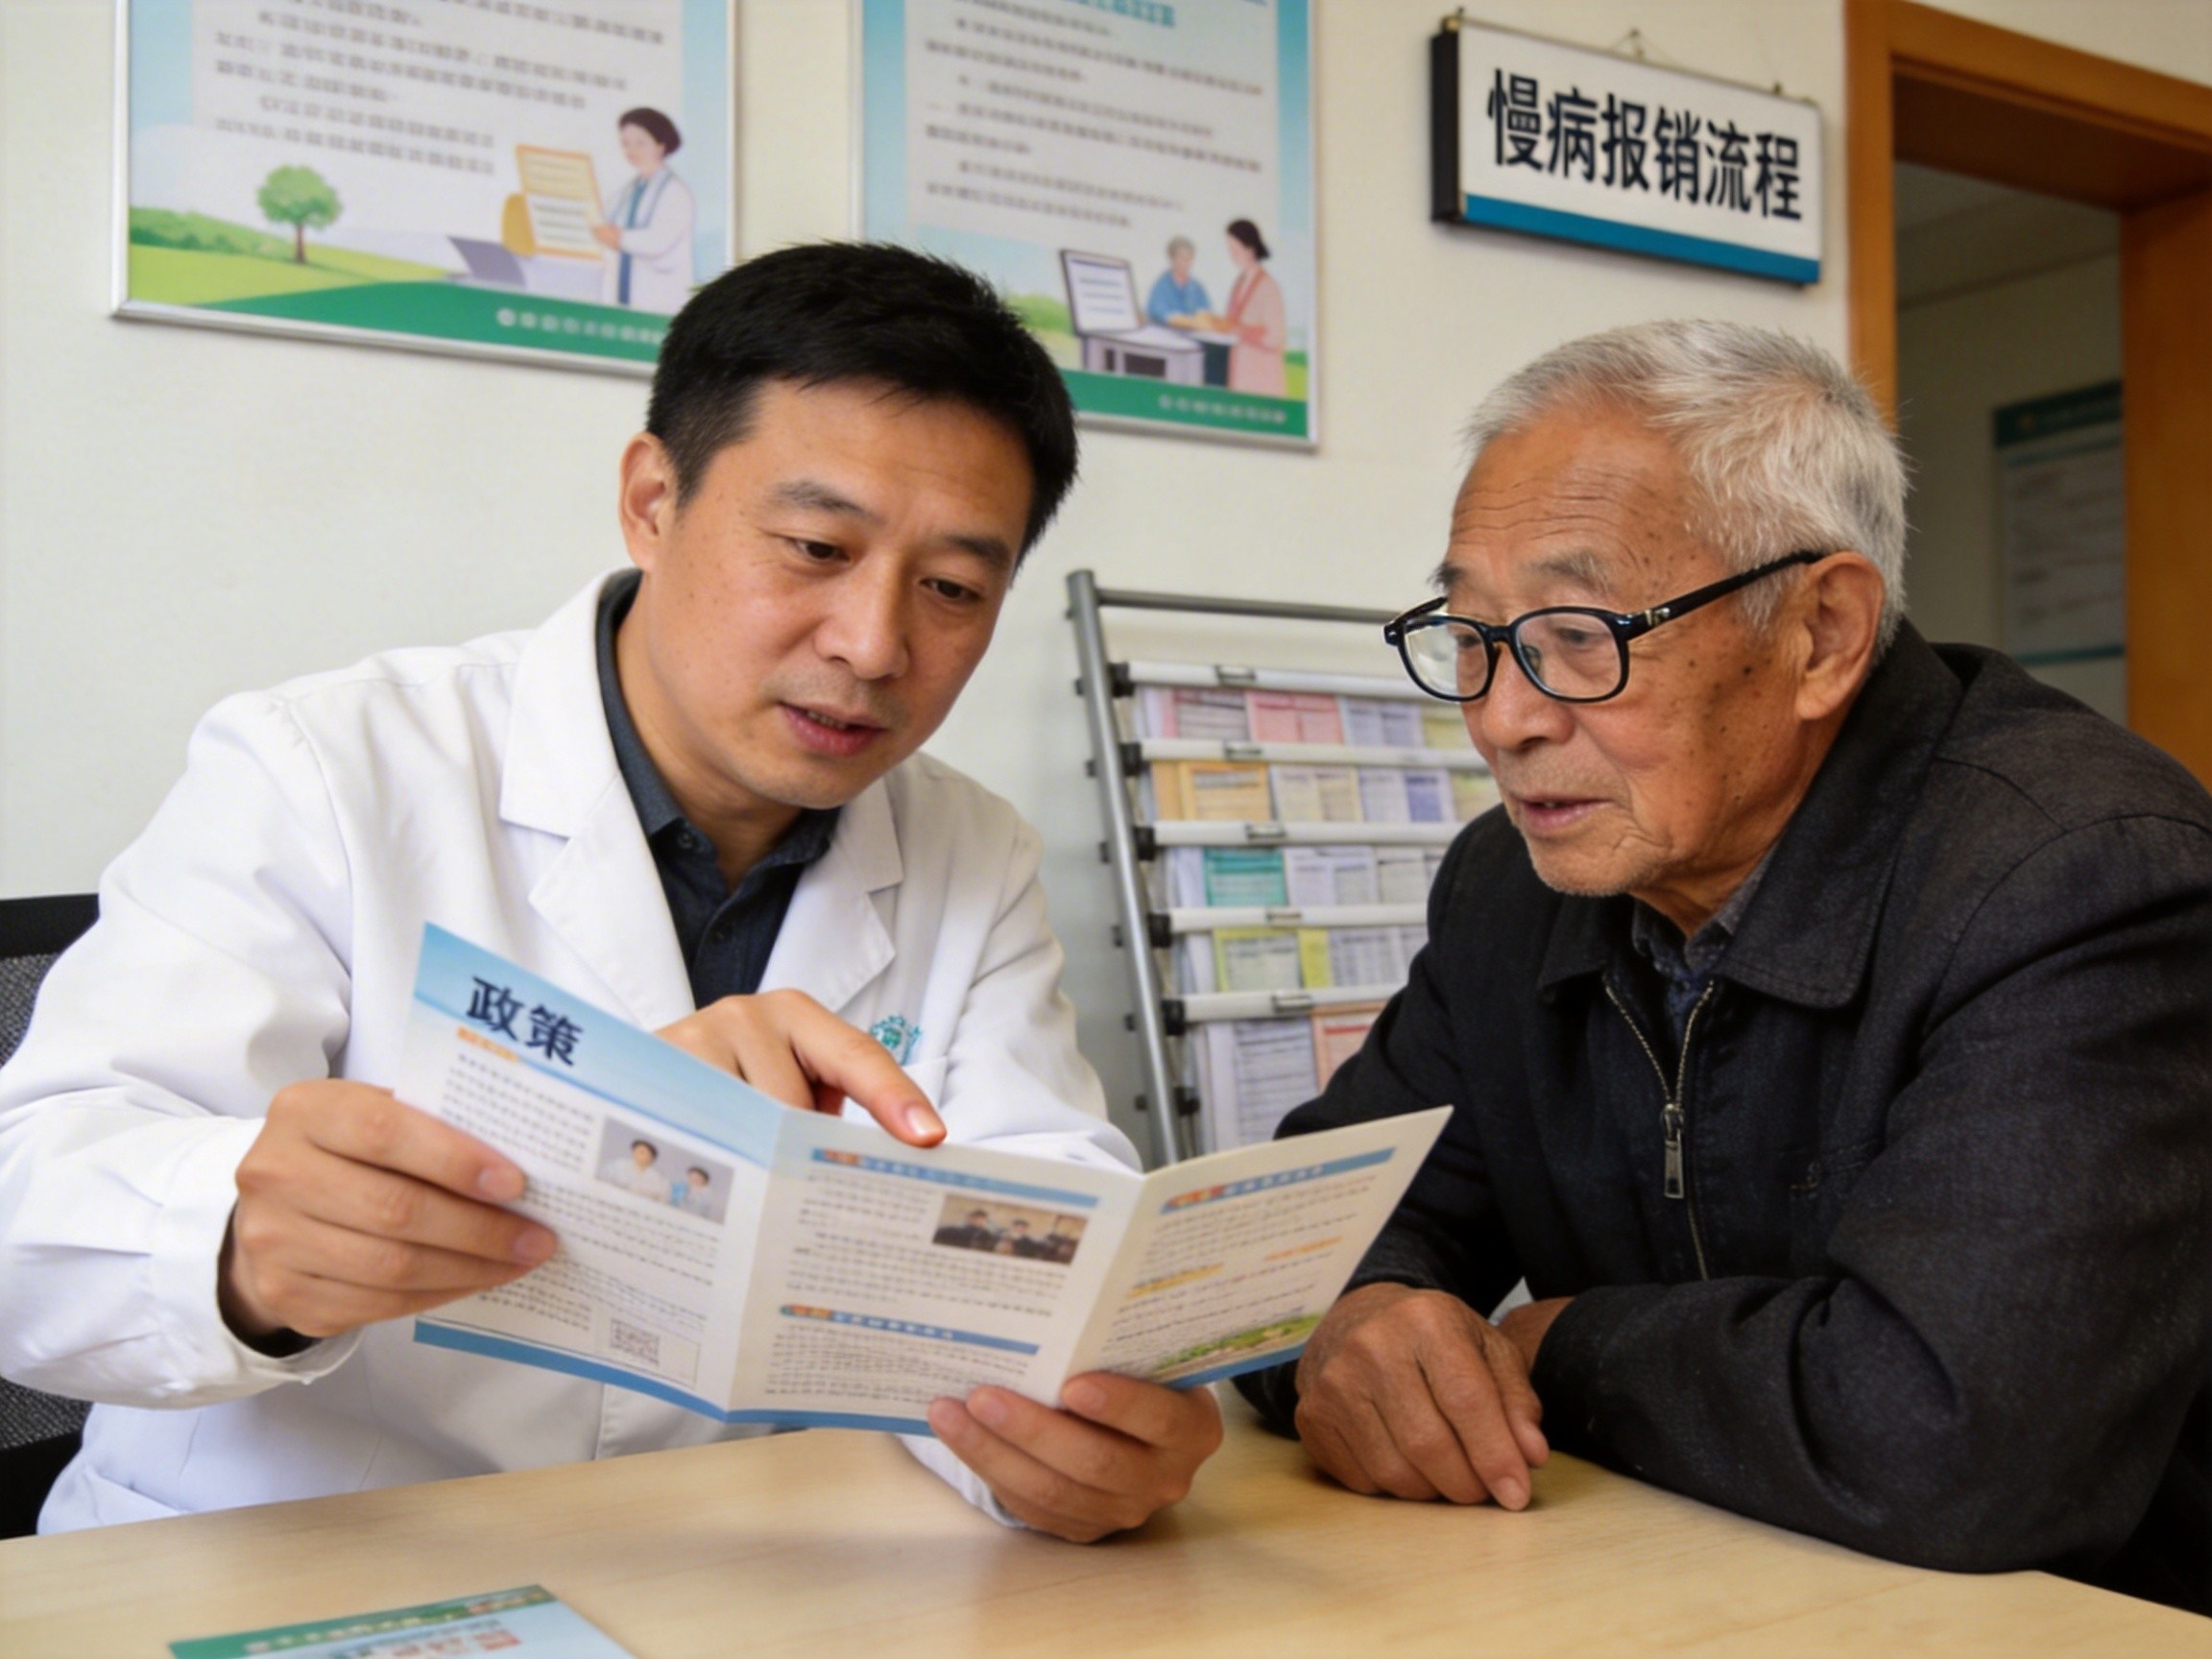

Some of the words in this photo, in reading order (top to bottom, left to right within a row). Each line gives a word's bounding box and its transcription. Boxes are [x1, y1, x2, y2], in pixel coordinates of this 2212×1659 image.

[1487, 68, 1802, 221] 慢病报销流程
[467, 976, 583, 1066] 政策
